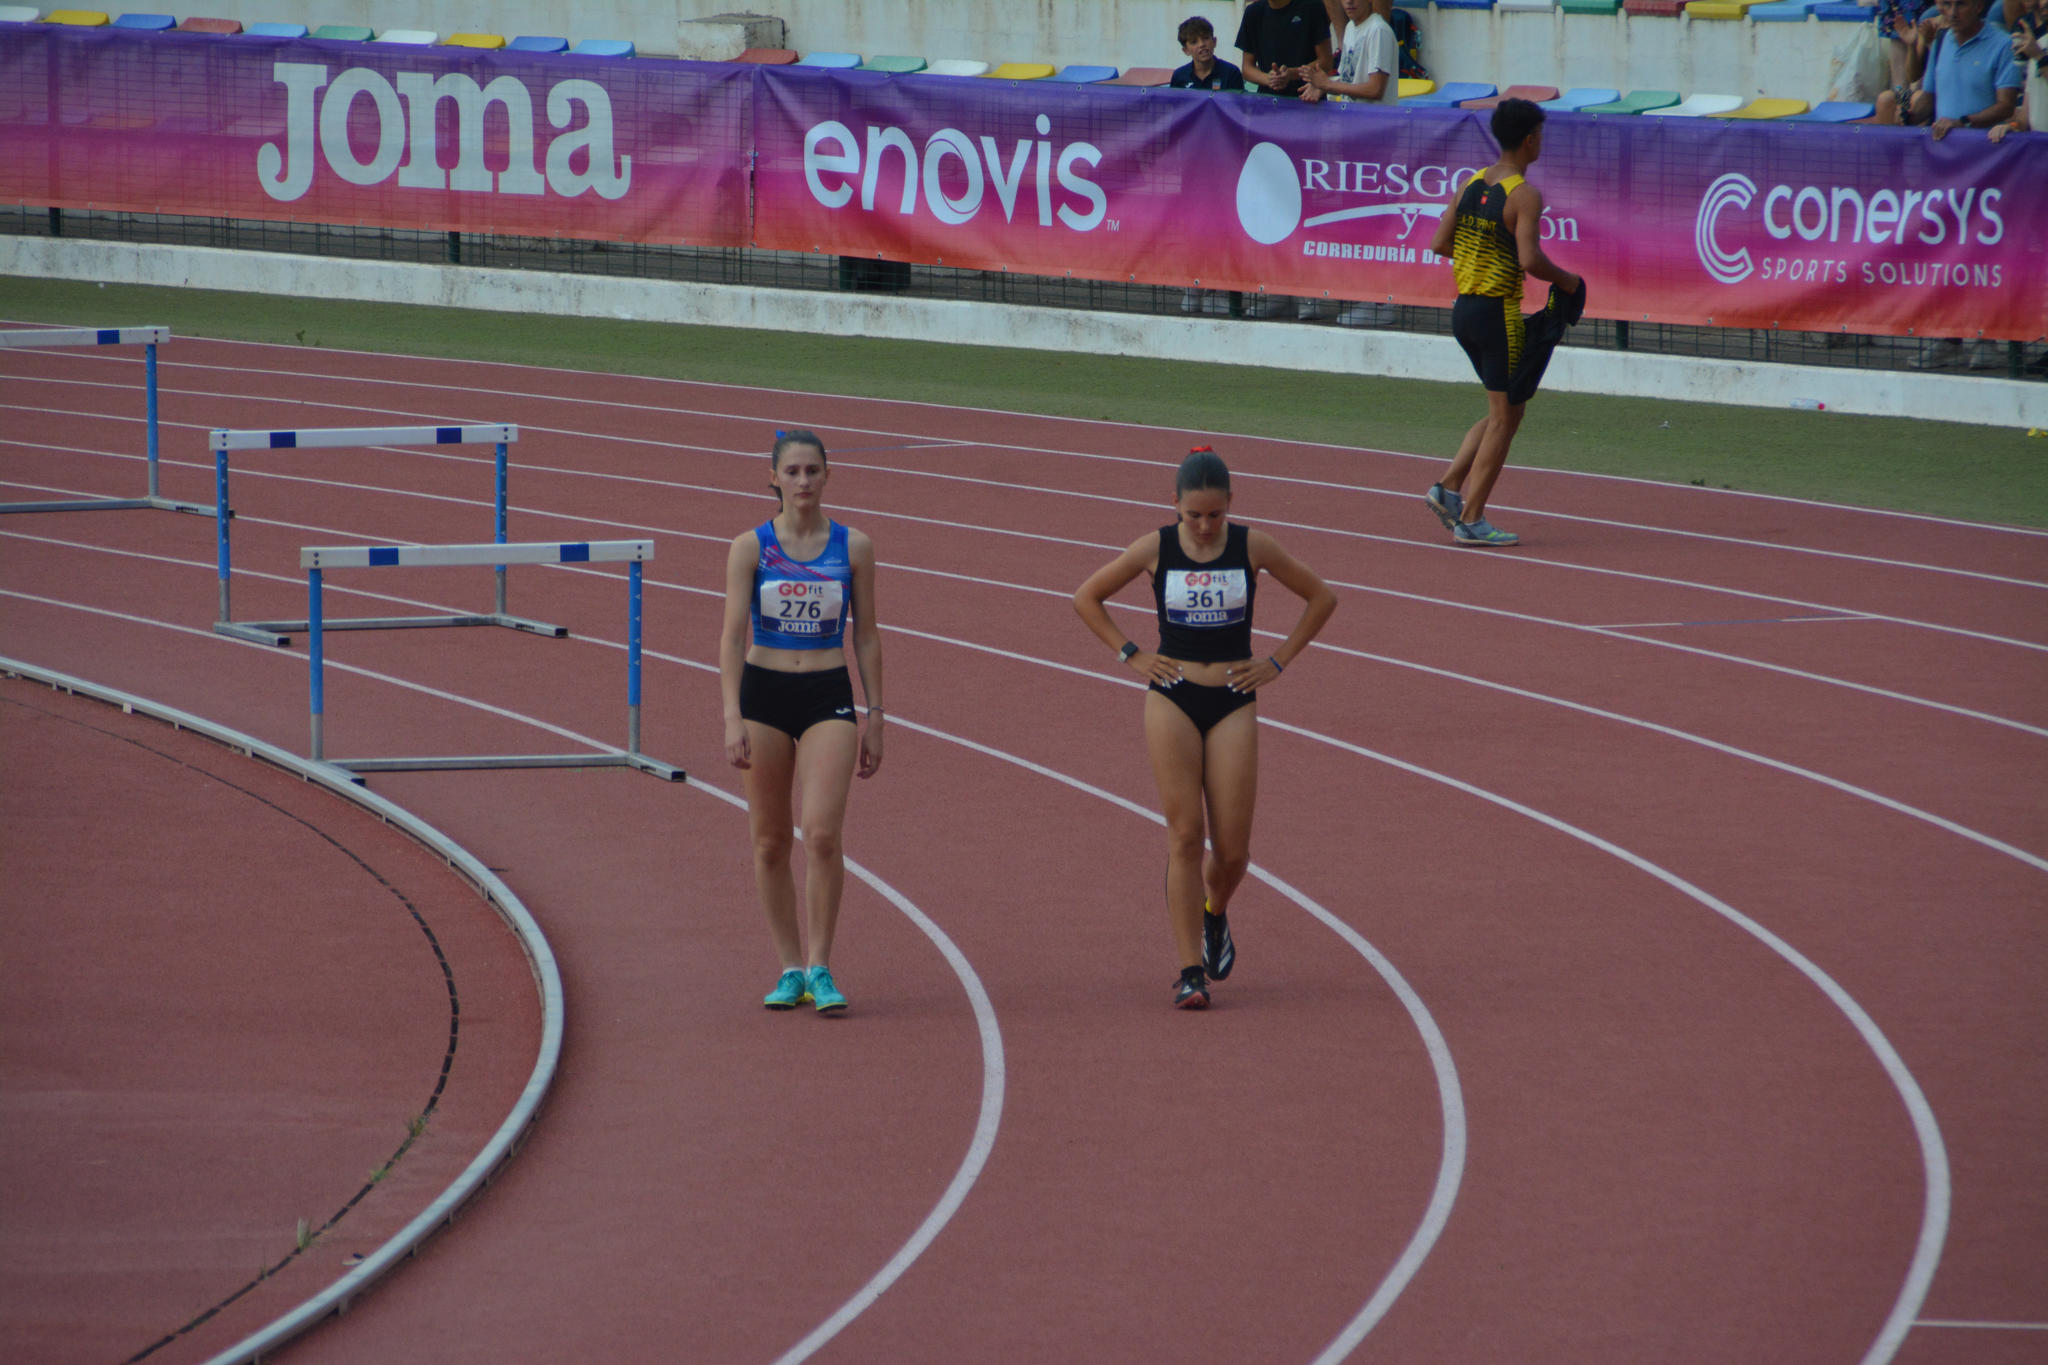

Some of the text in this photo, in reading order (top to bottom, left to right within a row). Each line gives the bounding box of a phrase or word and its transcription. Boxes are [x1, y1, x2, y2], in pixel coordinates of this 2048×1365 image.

[803, 113, 1107, 232] enovis
[1303, 240, 1416, 264] CORREDURÍA
[1761, 257, 2003, 287] SPORTS SOLUTIONS
[780, 600, 821, 619] 276
[1186, 590, 1225, 609] 361
